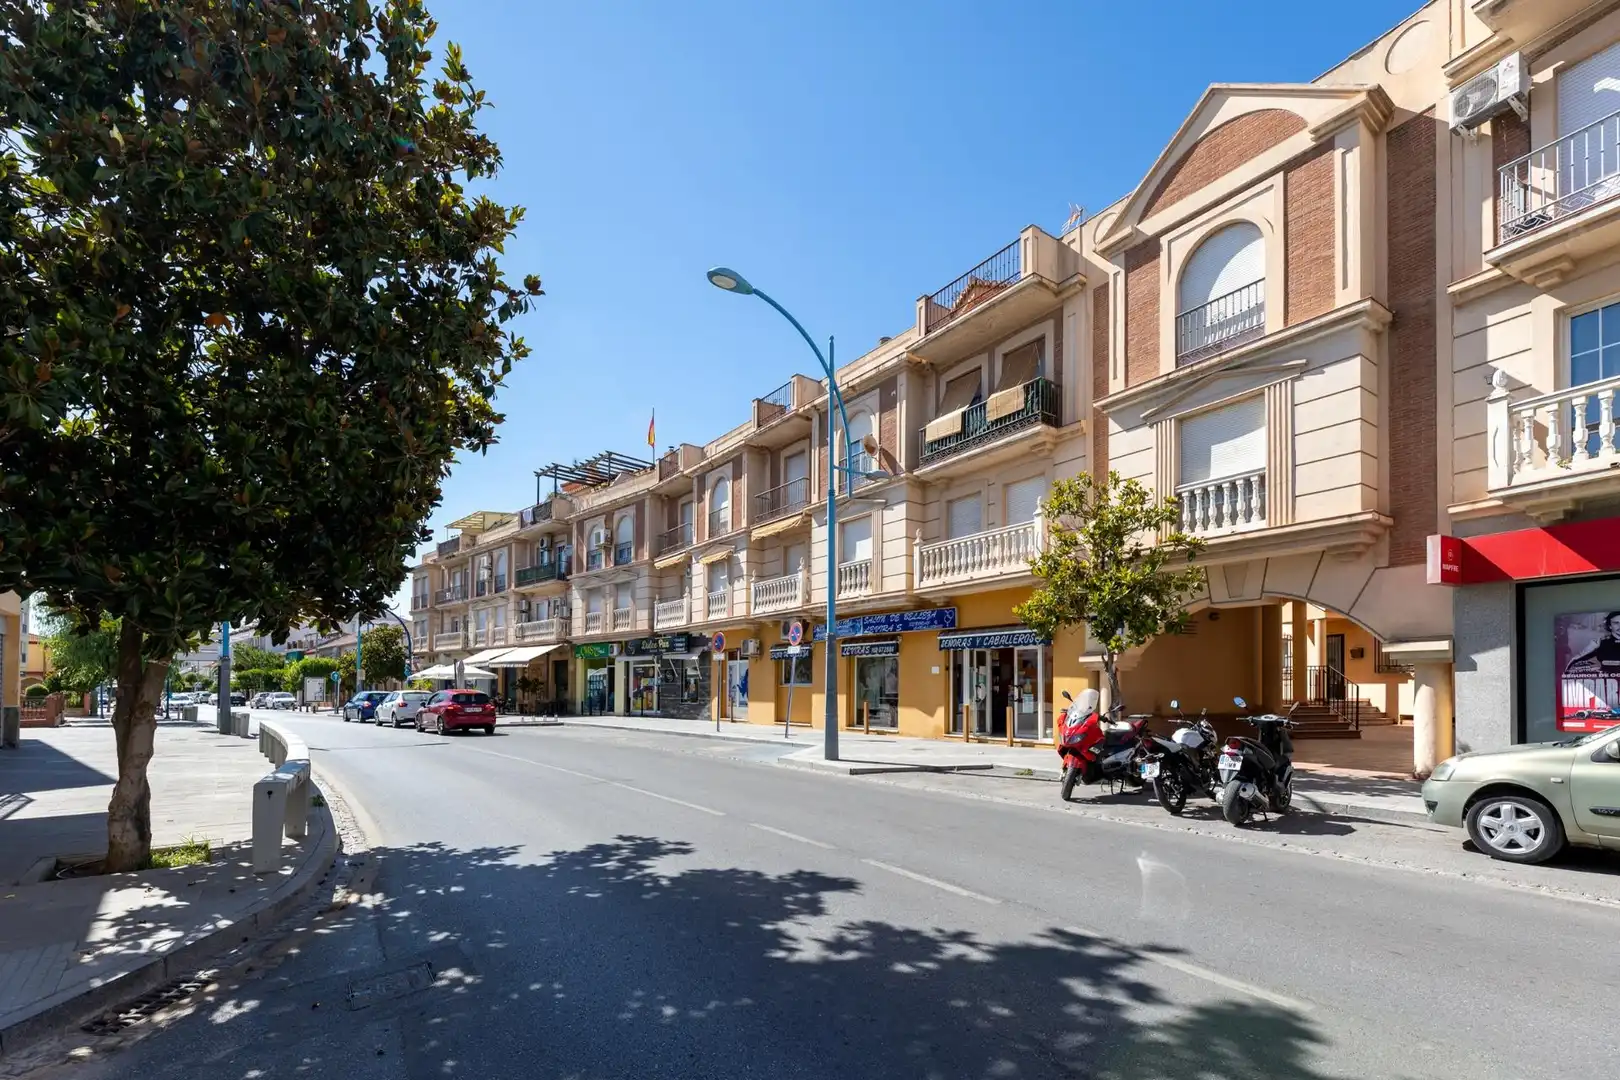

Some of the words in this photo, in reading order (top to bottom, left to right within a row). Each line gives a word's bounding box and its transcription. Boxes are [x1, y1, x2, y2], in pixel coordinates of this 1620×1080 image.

[890, 613, 900, 623] DE
[976, 636, 982, 646] Y
[983, 632, 1036, 646] CABALLEROS
